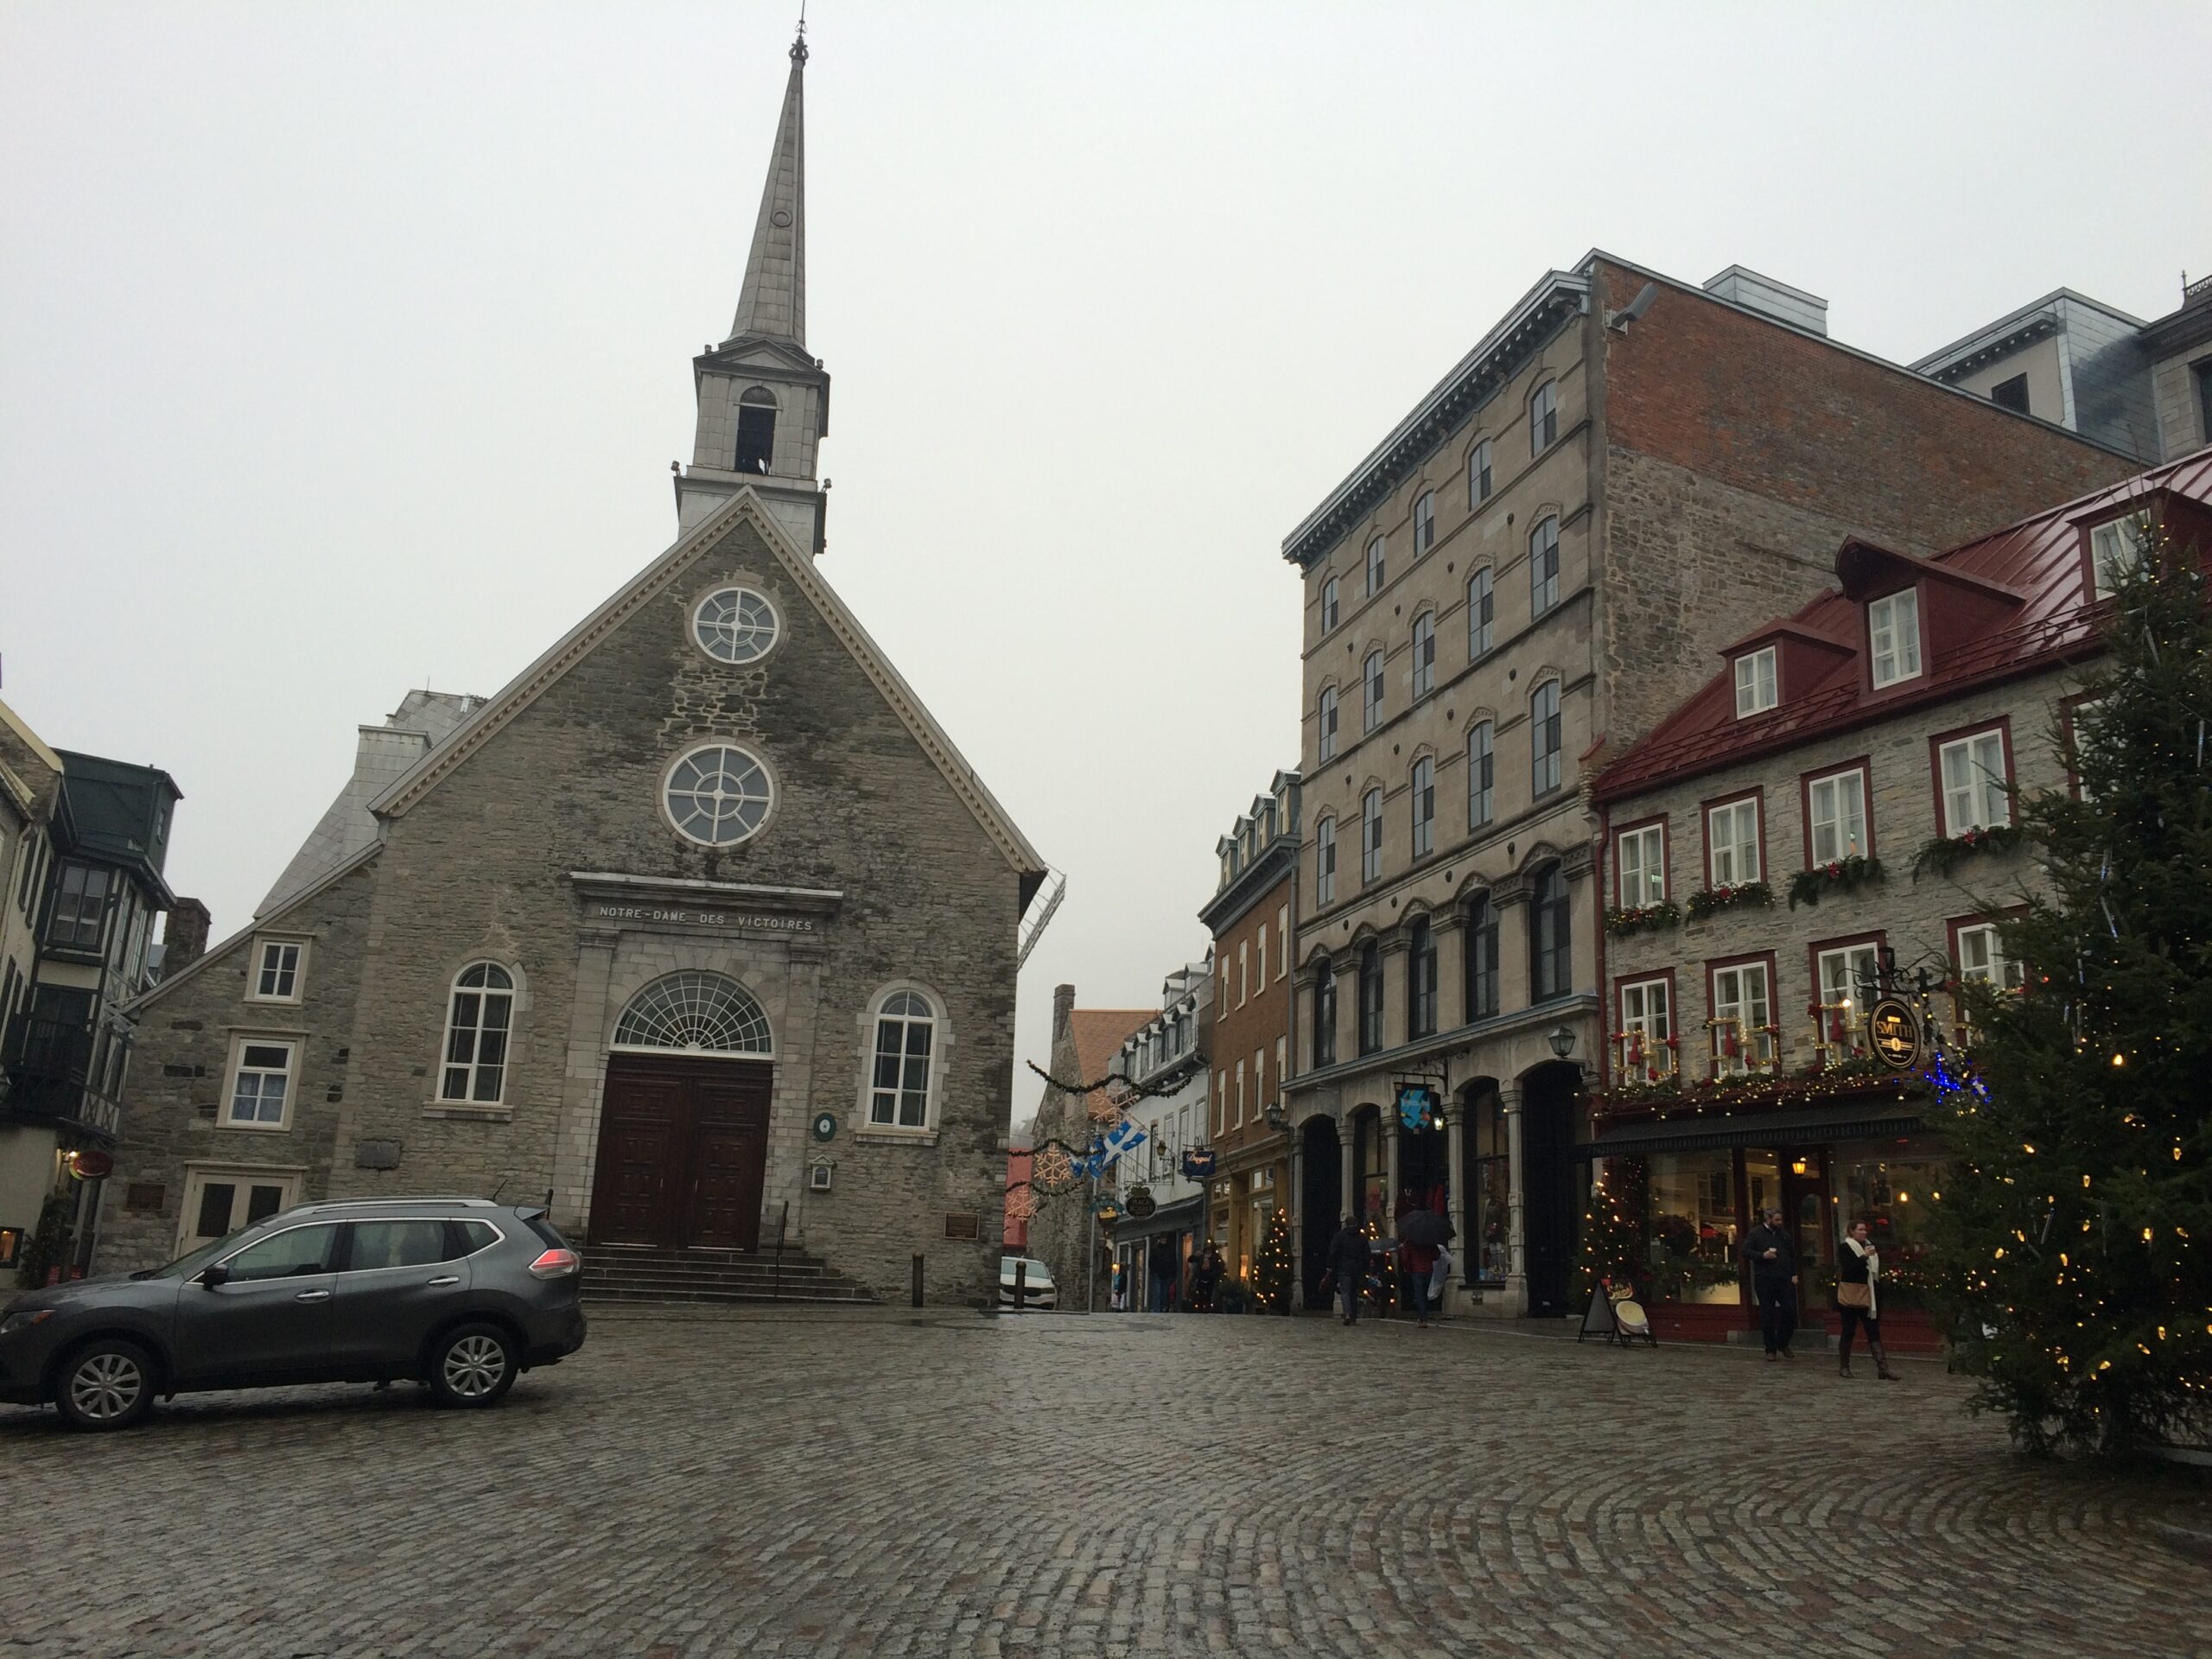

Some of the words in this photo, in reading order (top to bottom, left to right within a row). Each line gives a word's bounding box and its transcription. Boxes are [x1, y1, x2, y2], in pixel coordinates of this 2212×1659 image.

[600, 907, 687, 922] NOTRE-DAME
[699, 913, 725, 925] DES
[738, 916, 812, 931] VICTOIRES
[1876, 1021, 1913, 1038] SMITH
